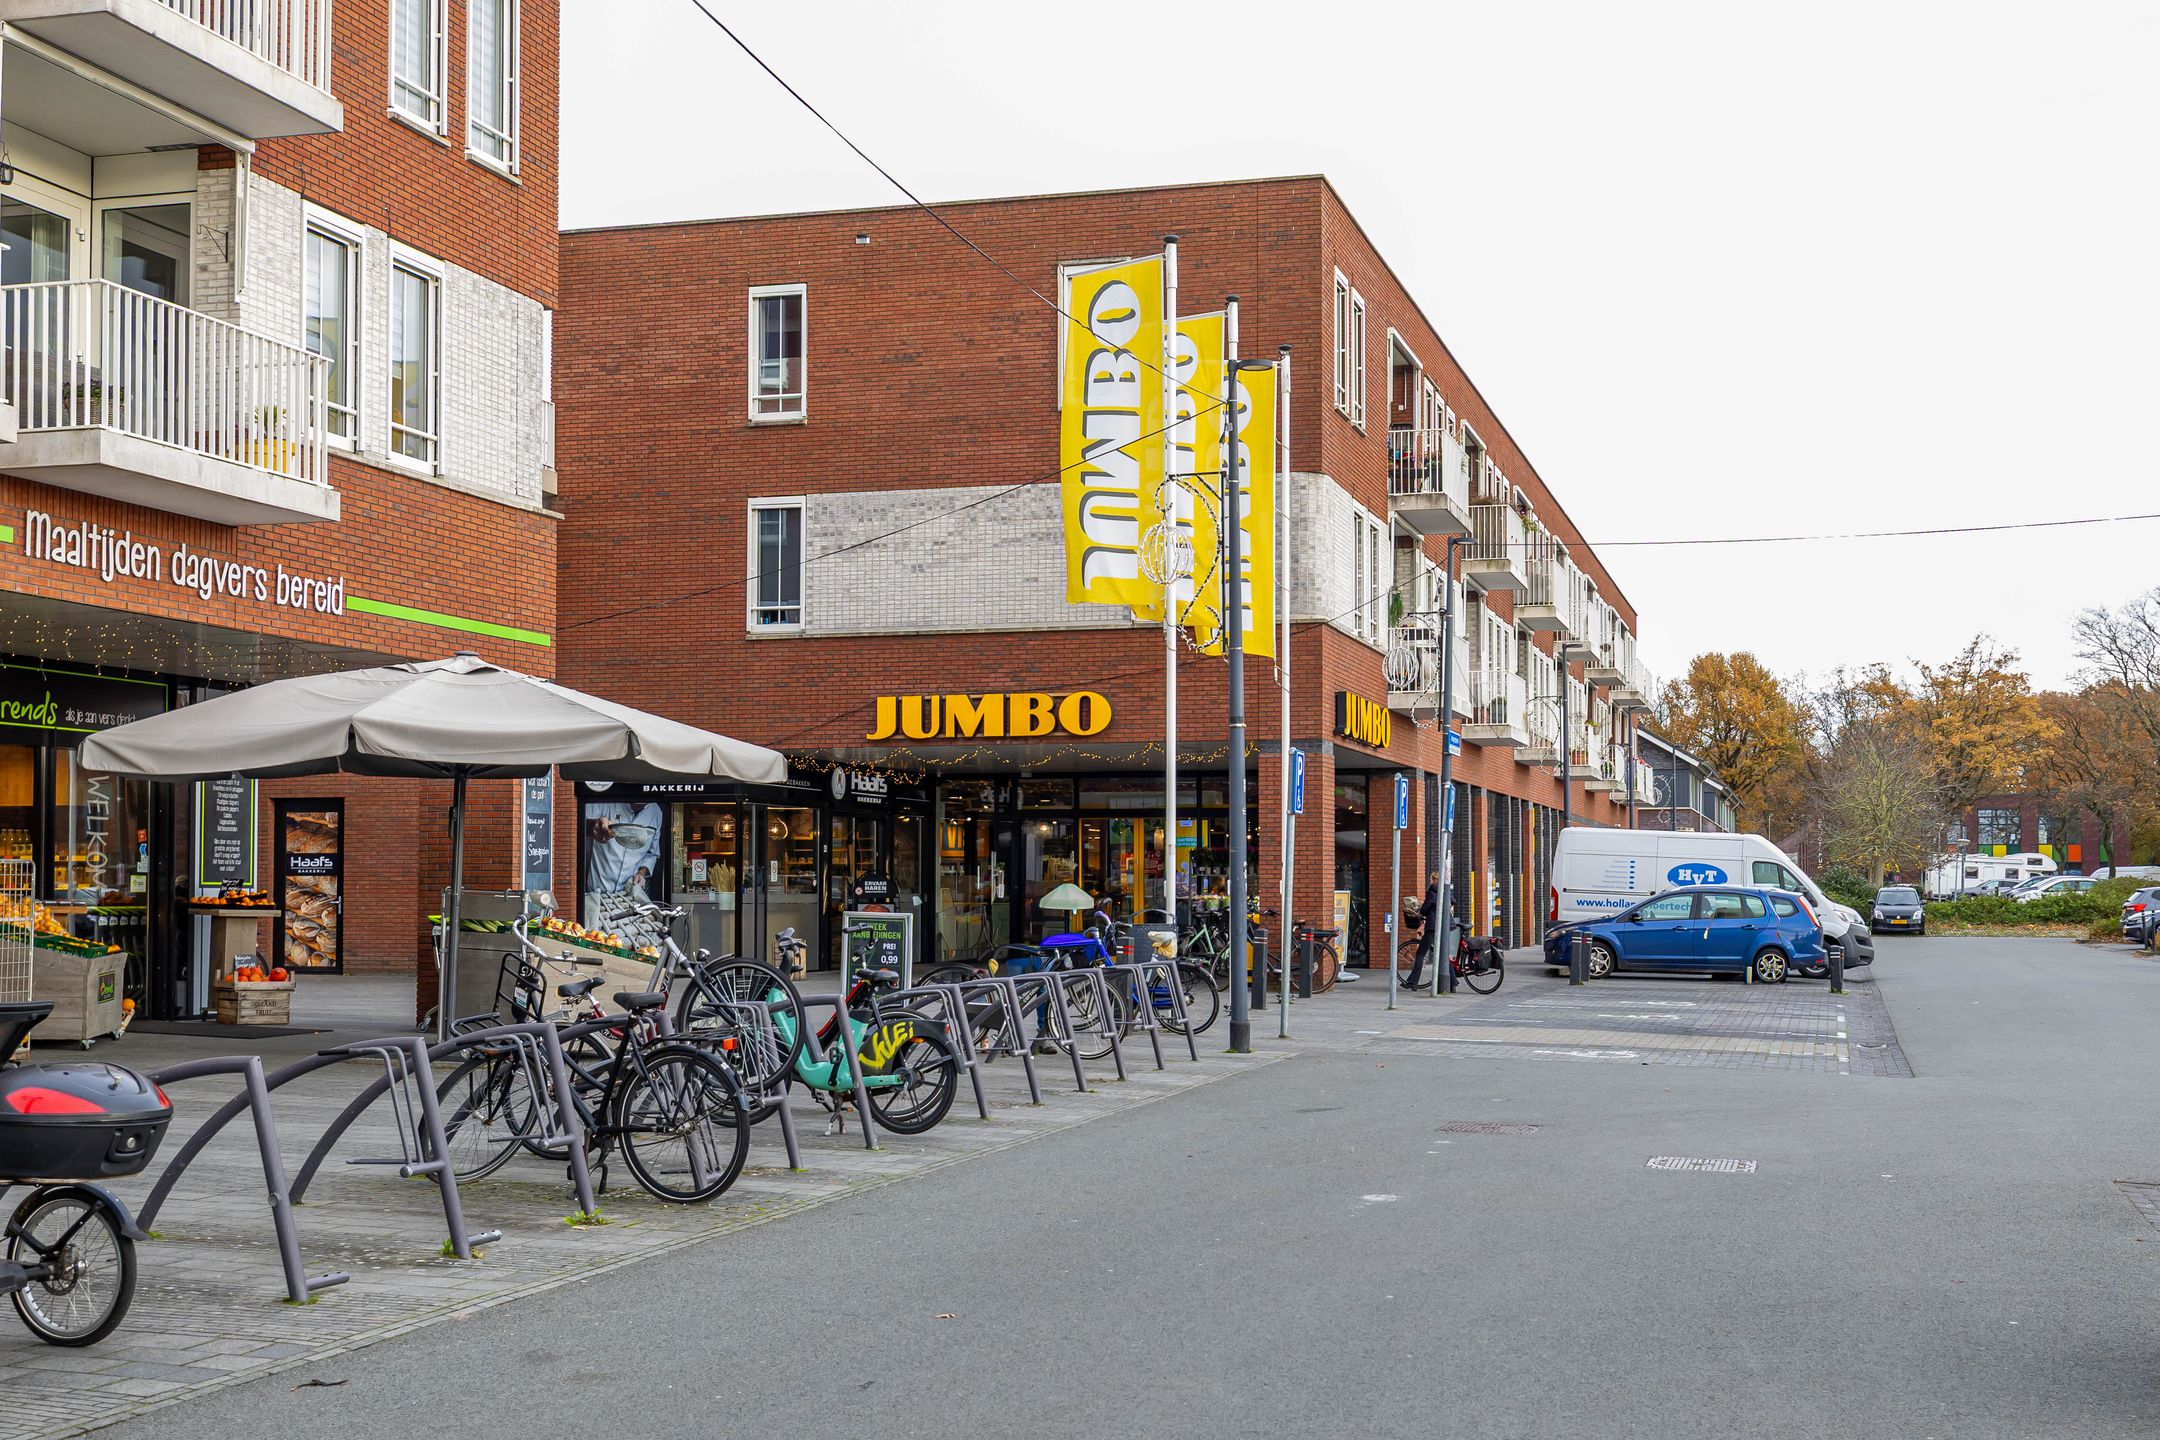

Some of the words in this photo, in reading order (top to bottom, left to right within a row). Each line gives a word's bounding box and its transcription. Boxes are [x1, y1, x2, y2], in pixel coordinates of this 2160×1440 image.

[25, 509, 161, 583] Maaltijden
[172, 542, 267, 600] dagvers
[276, 564, 344, 616] bereid
[99, 714, 115, 726] vers
[866, 691, 1112, 740] JUMBO
[1344, 691, 1391, 749] JUMBO
[851, 771, 888, 793] Haafs
[642, 784, 705, 792] BAKKERIJ
[290, 856, 333, 867] Haafs
[852, 931, 901, 939] AANBEDINGEN
[880, 955, 898, 964] 0,99
[255, 1009, 273, 1017] FRUIT
